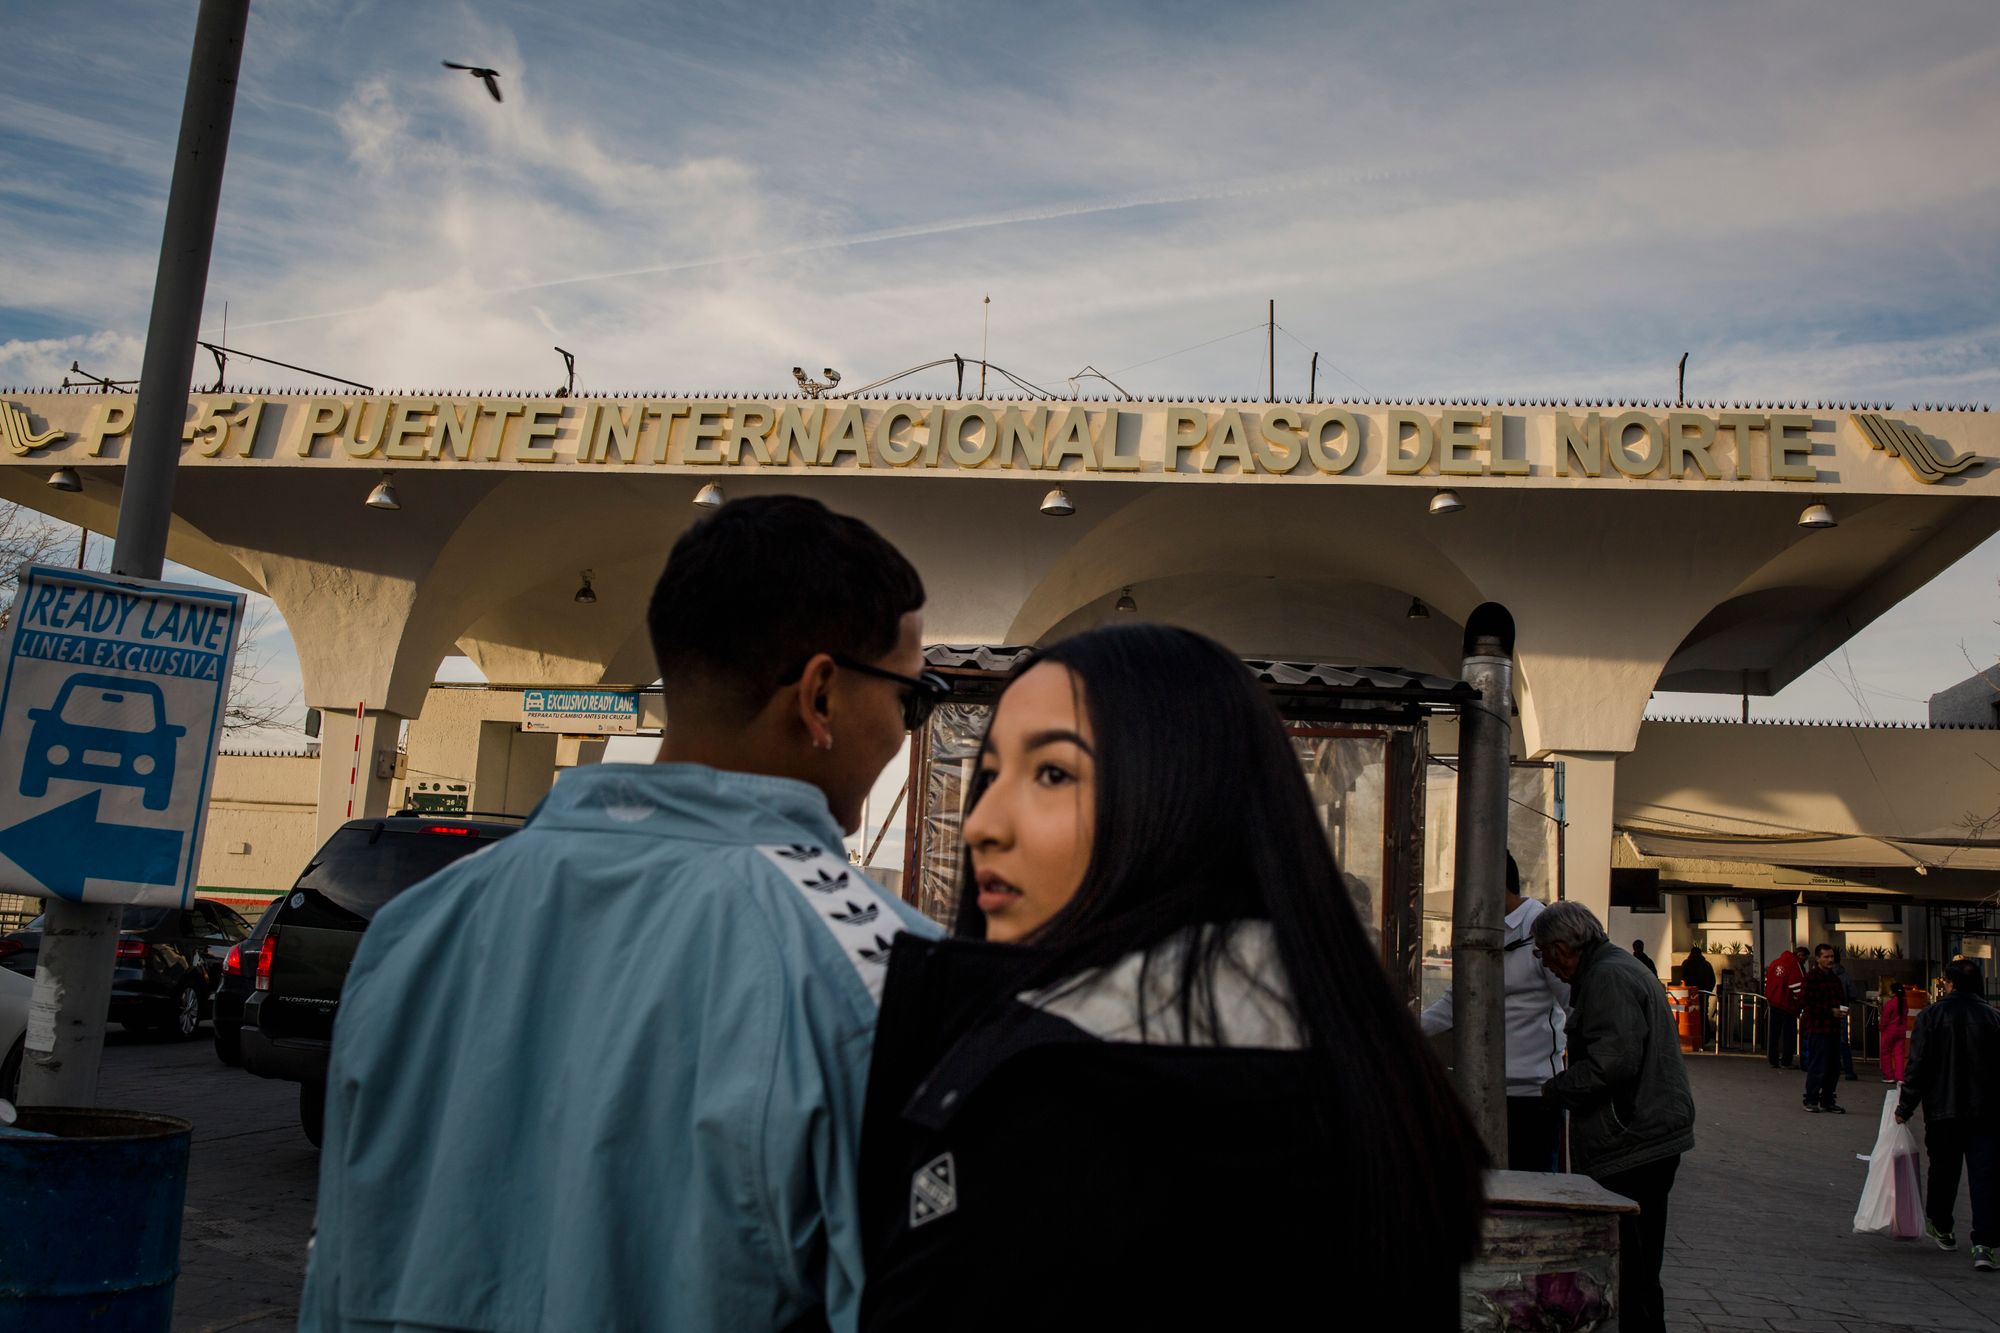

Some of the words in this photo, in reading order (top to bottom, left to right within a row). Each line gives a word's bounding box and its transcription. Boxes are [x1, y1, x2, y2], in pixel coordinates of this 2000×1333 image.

[88, 399, 266, 459] P-51
[297, 400, 566, 462] PUENTE
[576, 402, 1141, 472] INTERNACIONAL
[1164, 407, 1361, 476] PASO
[1386, 409, 1530, 477] DEL
[1555, 410, 1817, 482] NORTE
[28, 583, 140, 635] READY
[141, 599, 228, 650] LANE
[18, 632, 89, 664] LINEA
[92, 642, 219, 680] EXCLUSIVA
[547, 694, 588, 711] EXCLUSIVO
[588, 695, 614, 712] READY
[614, 697, 634, 712] LANE
